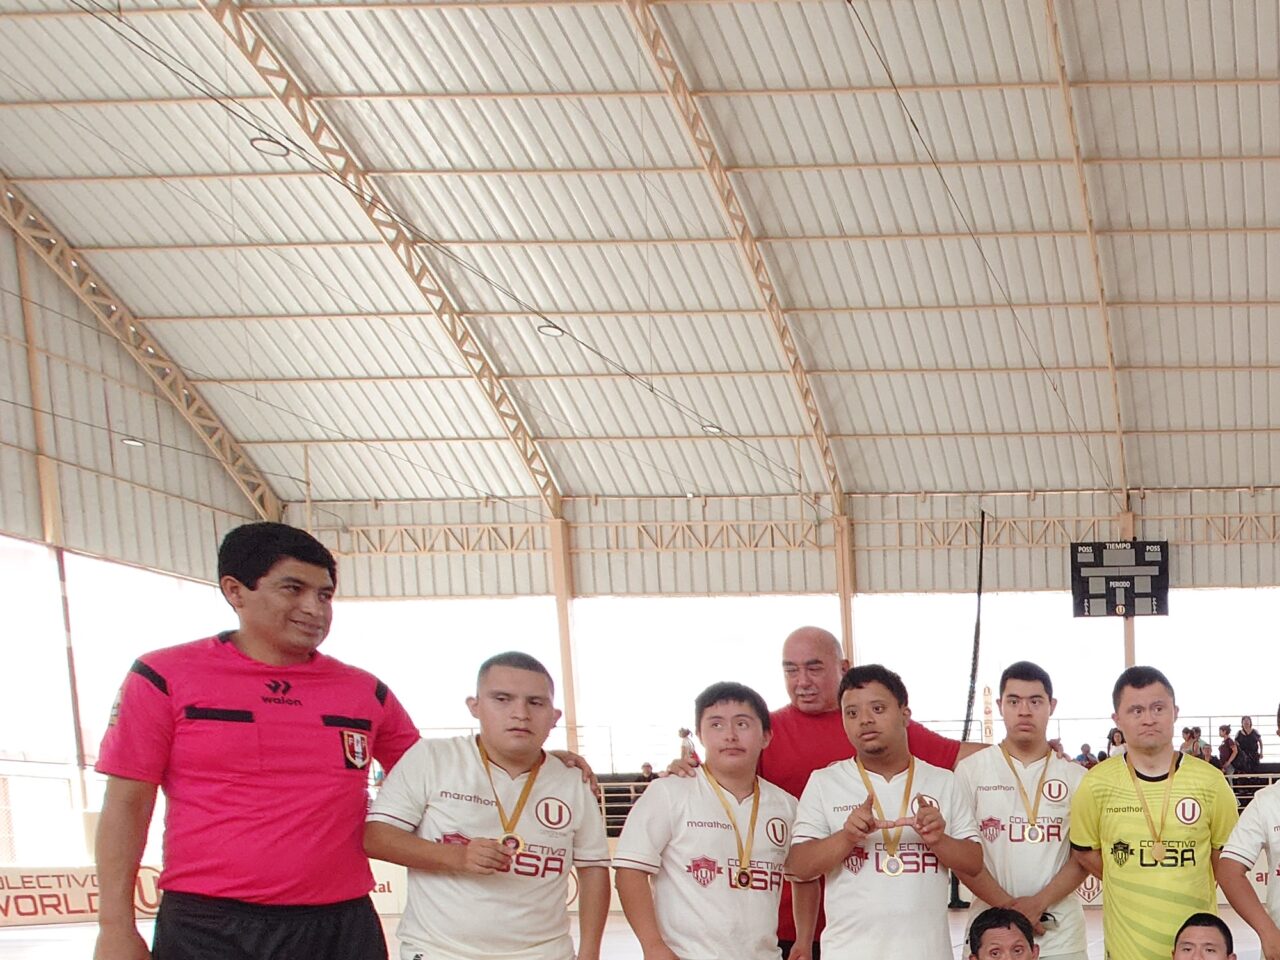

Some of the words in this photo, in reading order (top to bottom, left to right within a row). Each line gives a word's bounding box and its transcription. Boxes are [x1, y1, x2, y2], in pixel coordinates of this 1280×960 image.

[261, 696, 303, 706] walon
[440, 790, 498, 807] marathon
[687, 820, 733, 831] marathon
[496, 852, 564, 878] SA
[0, 874, 98, 889] LECTIV
